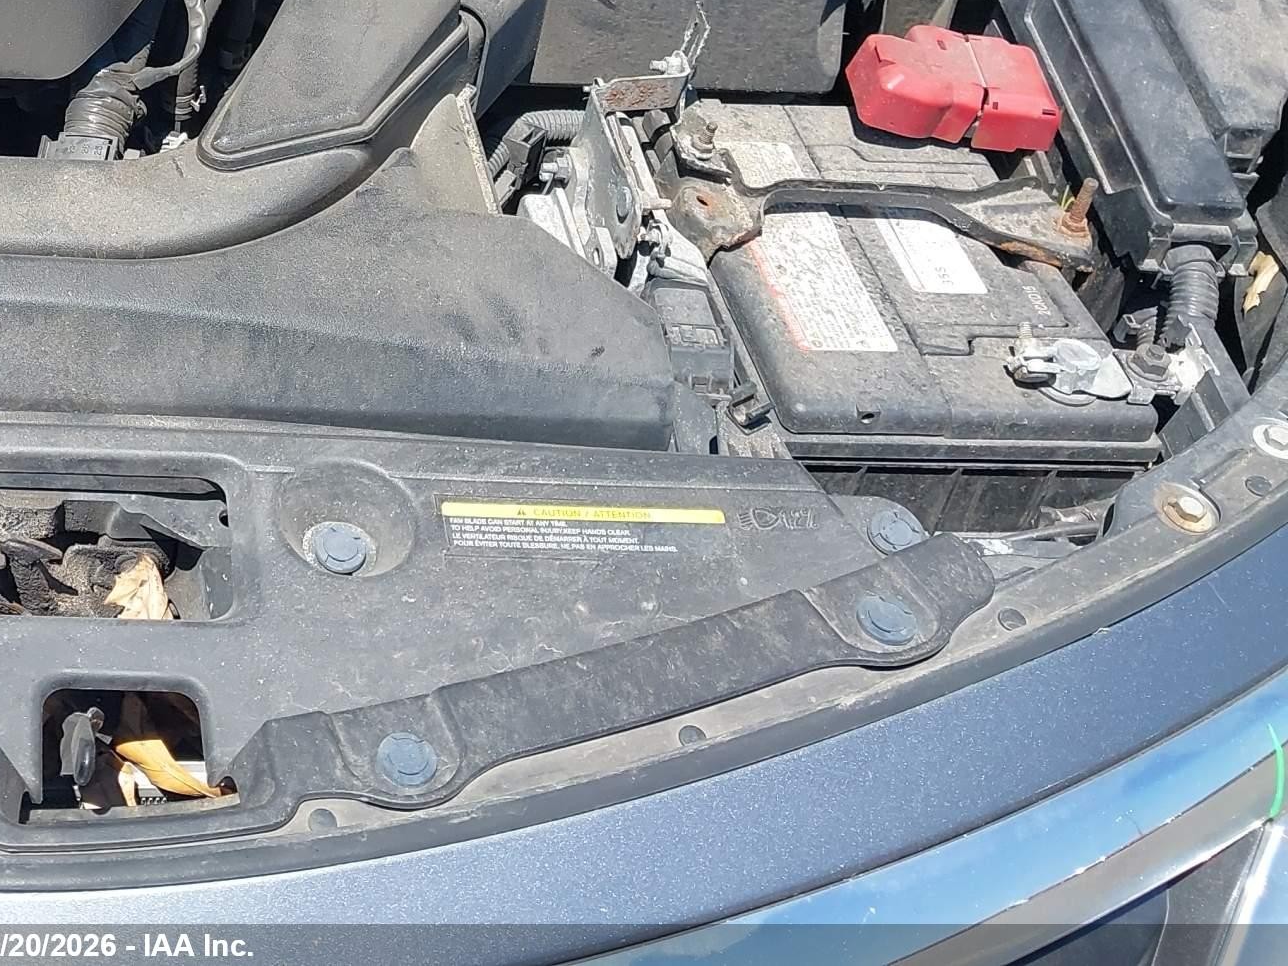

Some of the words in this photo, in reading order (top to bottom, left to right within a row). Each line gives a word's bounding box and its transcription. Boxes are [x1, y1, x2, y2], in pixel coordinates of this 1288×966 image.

[533, 509, 581, 517] CAUTION
[593, 510, 651, 520] ATTENTION
[582, 528, 607, 536] HANDS
